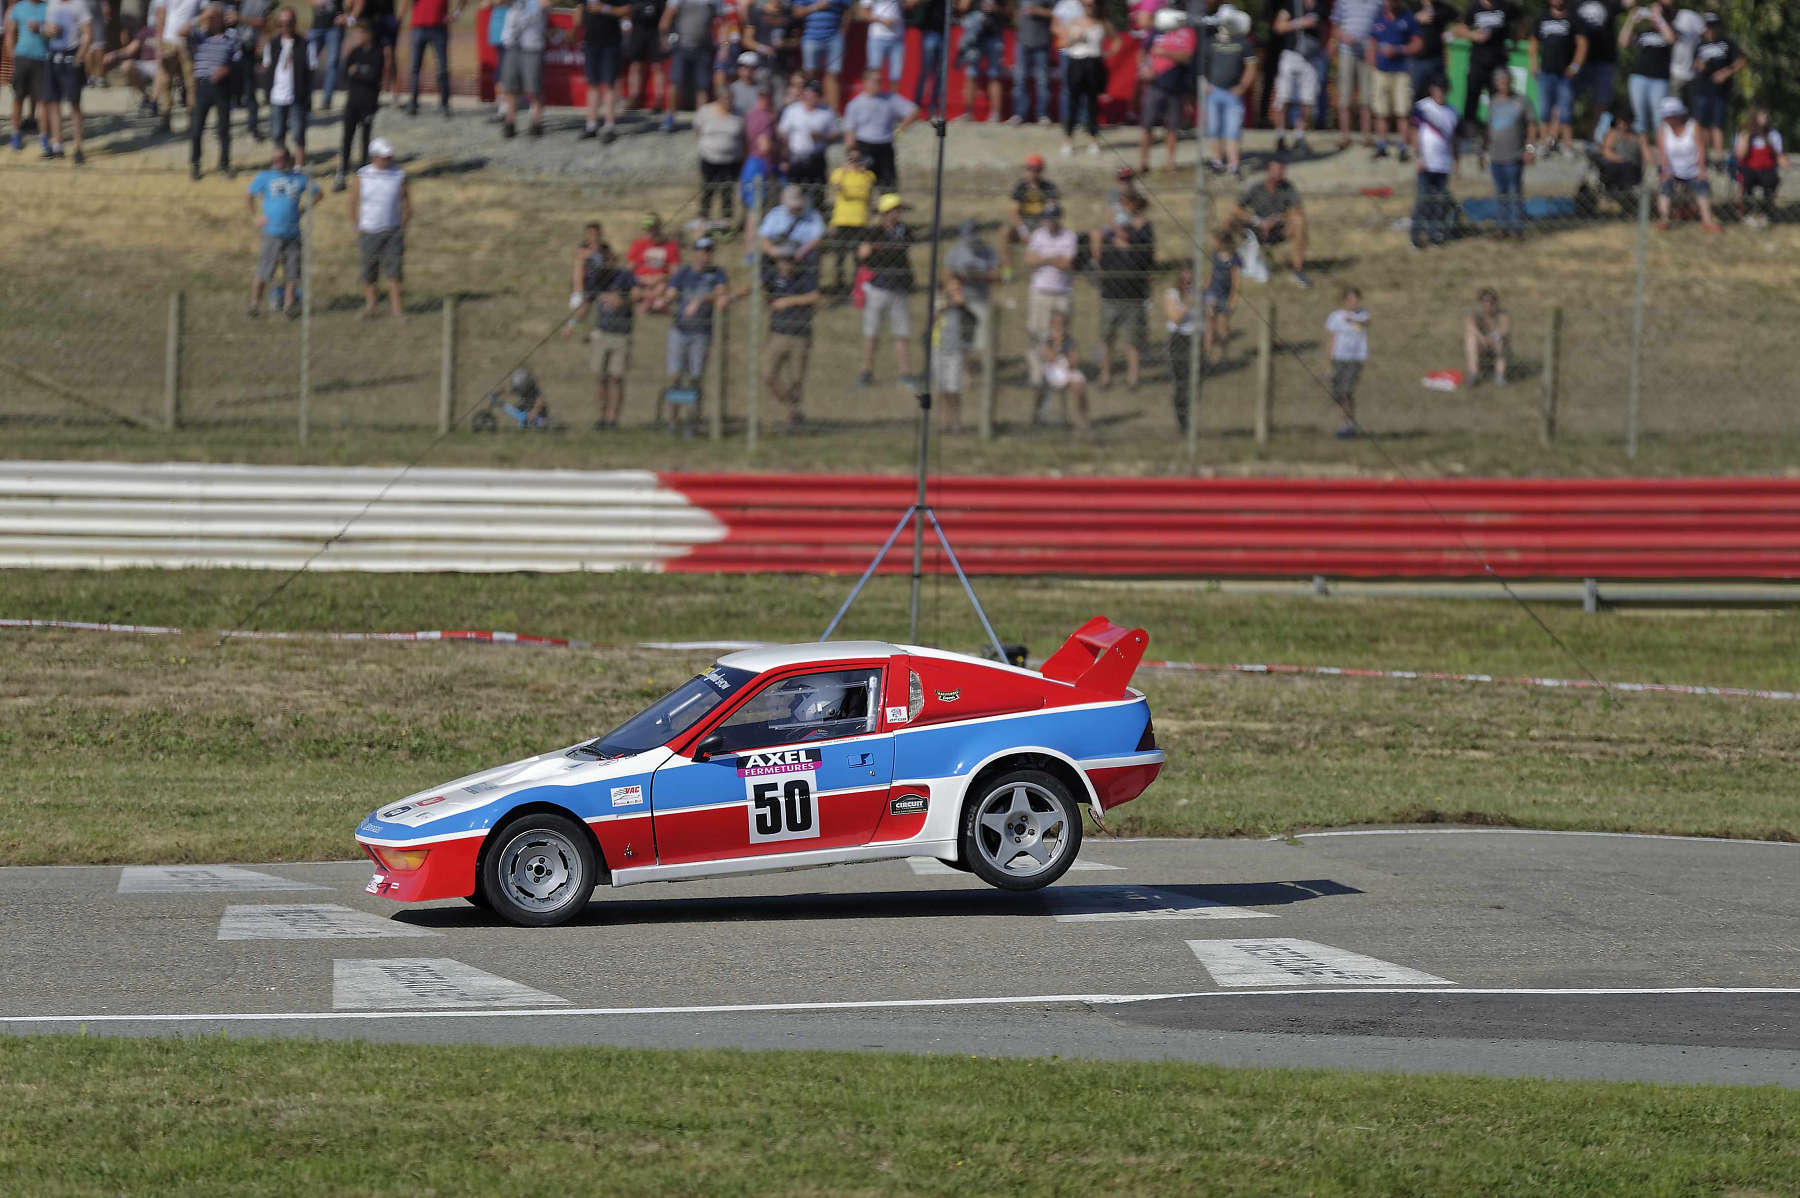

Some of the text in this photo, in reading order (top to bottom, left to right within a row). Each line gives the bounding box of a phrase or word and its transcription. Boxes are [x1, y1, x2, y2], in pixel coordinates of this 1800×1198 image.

[746, 750, 812, 768] AXEL
[744, 763, 815, 776] FERMETURES
[753, 780, 812, 835] 50
[895, 800, 924, 808] CIRCUIT
